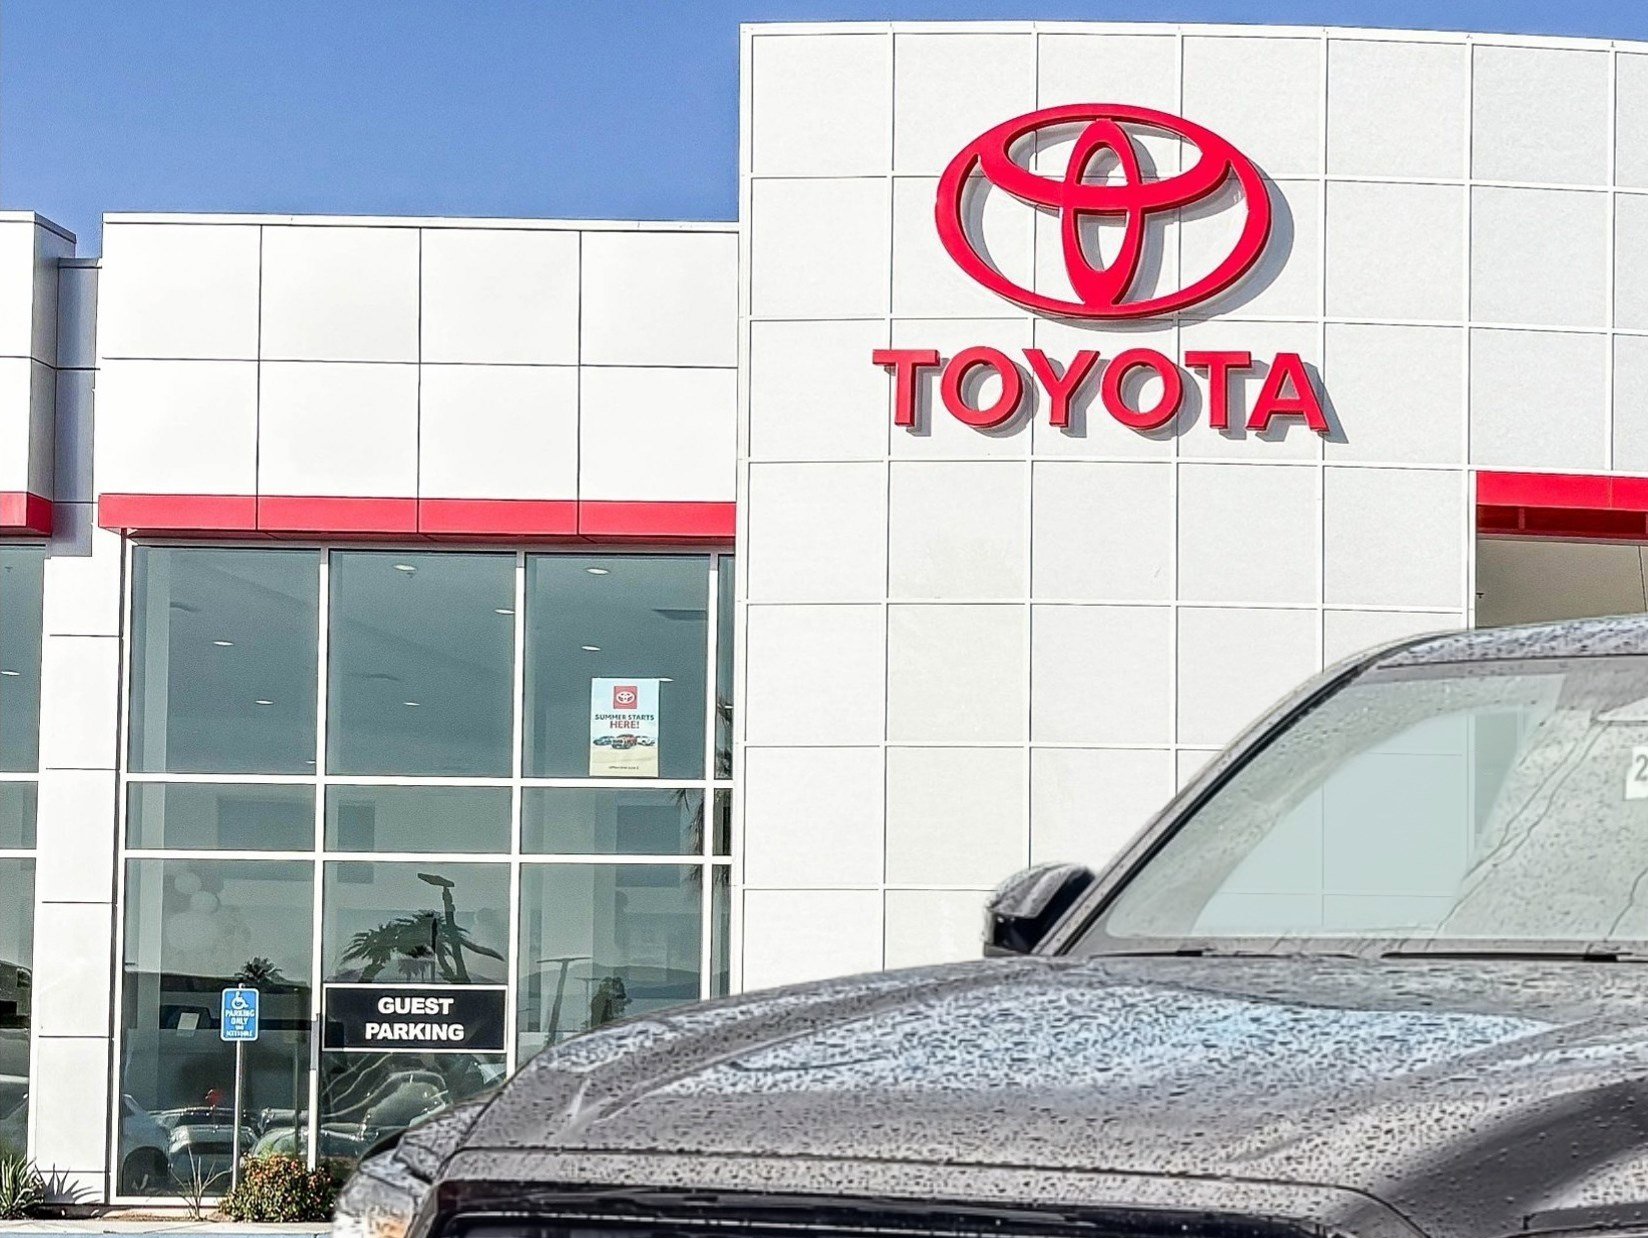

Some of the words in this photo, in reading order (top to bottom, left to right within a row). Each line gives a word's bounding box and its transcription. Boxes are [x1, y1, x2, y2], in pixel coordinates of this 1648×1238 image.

[872, 346, 1330, 432] TOYOTA
[610, 720, 640, 729] HERE!
[377, 997, 455, 1015] GUEST
[364, 1022, 465, 1041] PARKING
